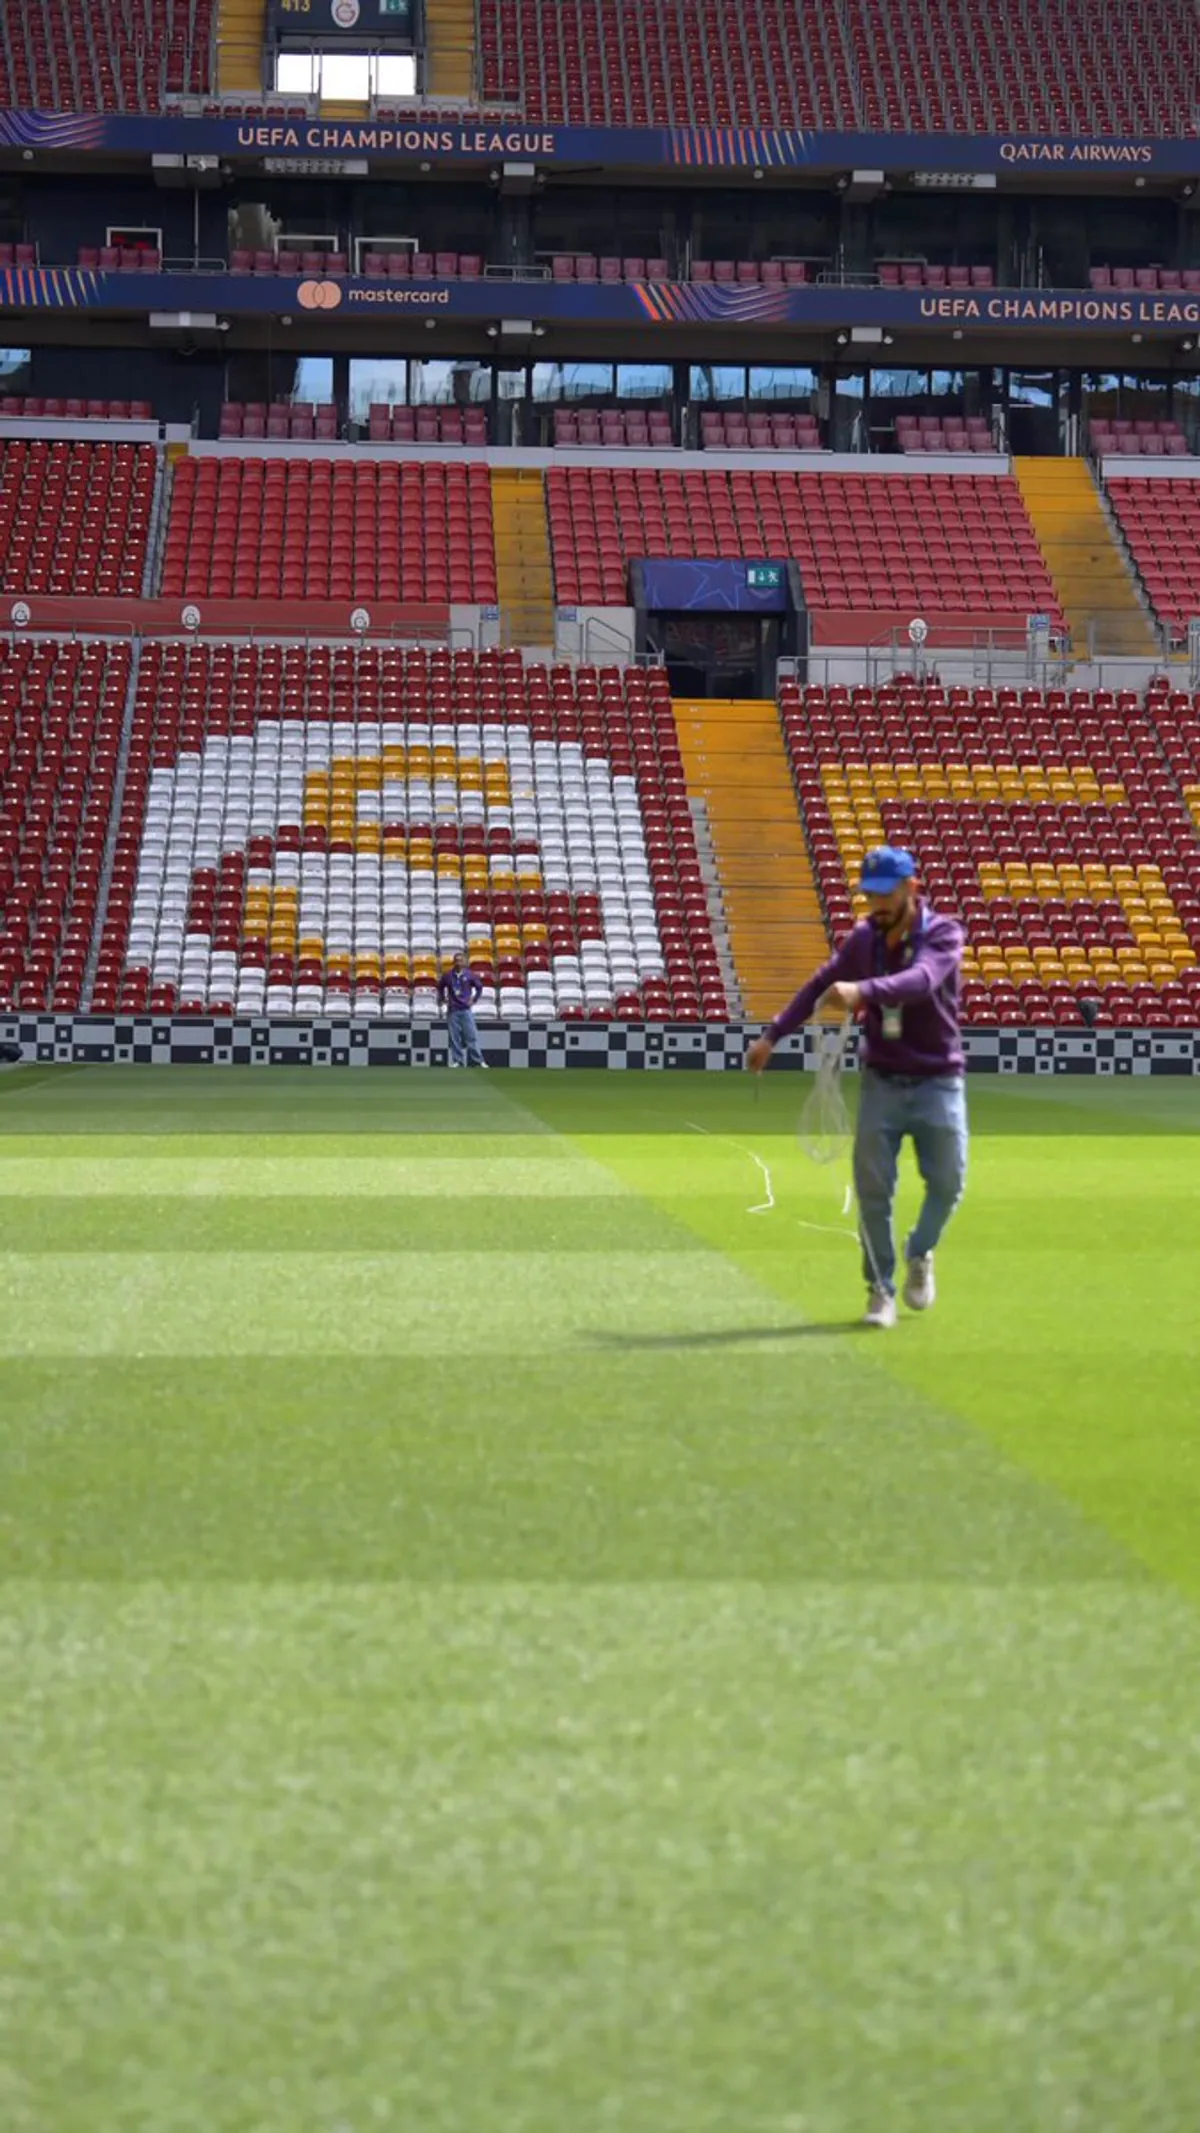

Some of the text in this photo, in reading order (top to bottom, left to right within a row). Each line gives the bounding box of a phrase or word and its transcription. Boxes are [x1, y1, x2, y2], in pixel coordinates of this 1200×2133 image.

[281, 0, 311, 12] 413
[238, 127, 555, 152] UEFA CHAMPIONS LEAGUE
[1000, 143, 1152, 163] QATAR AIRWAYS
[348, 288, 449, 303] mastercard
[920, 298, 1199, 322] UEFA CHAMPIONS LEAG
